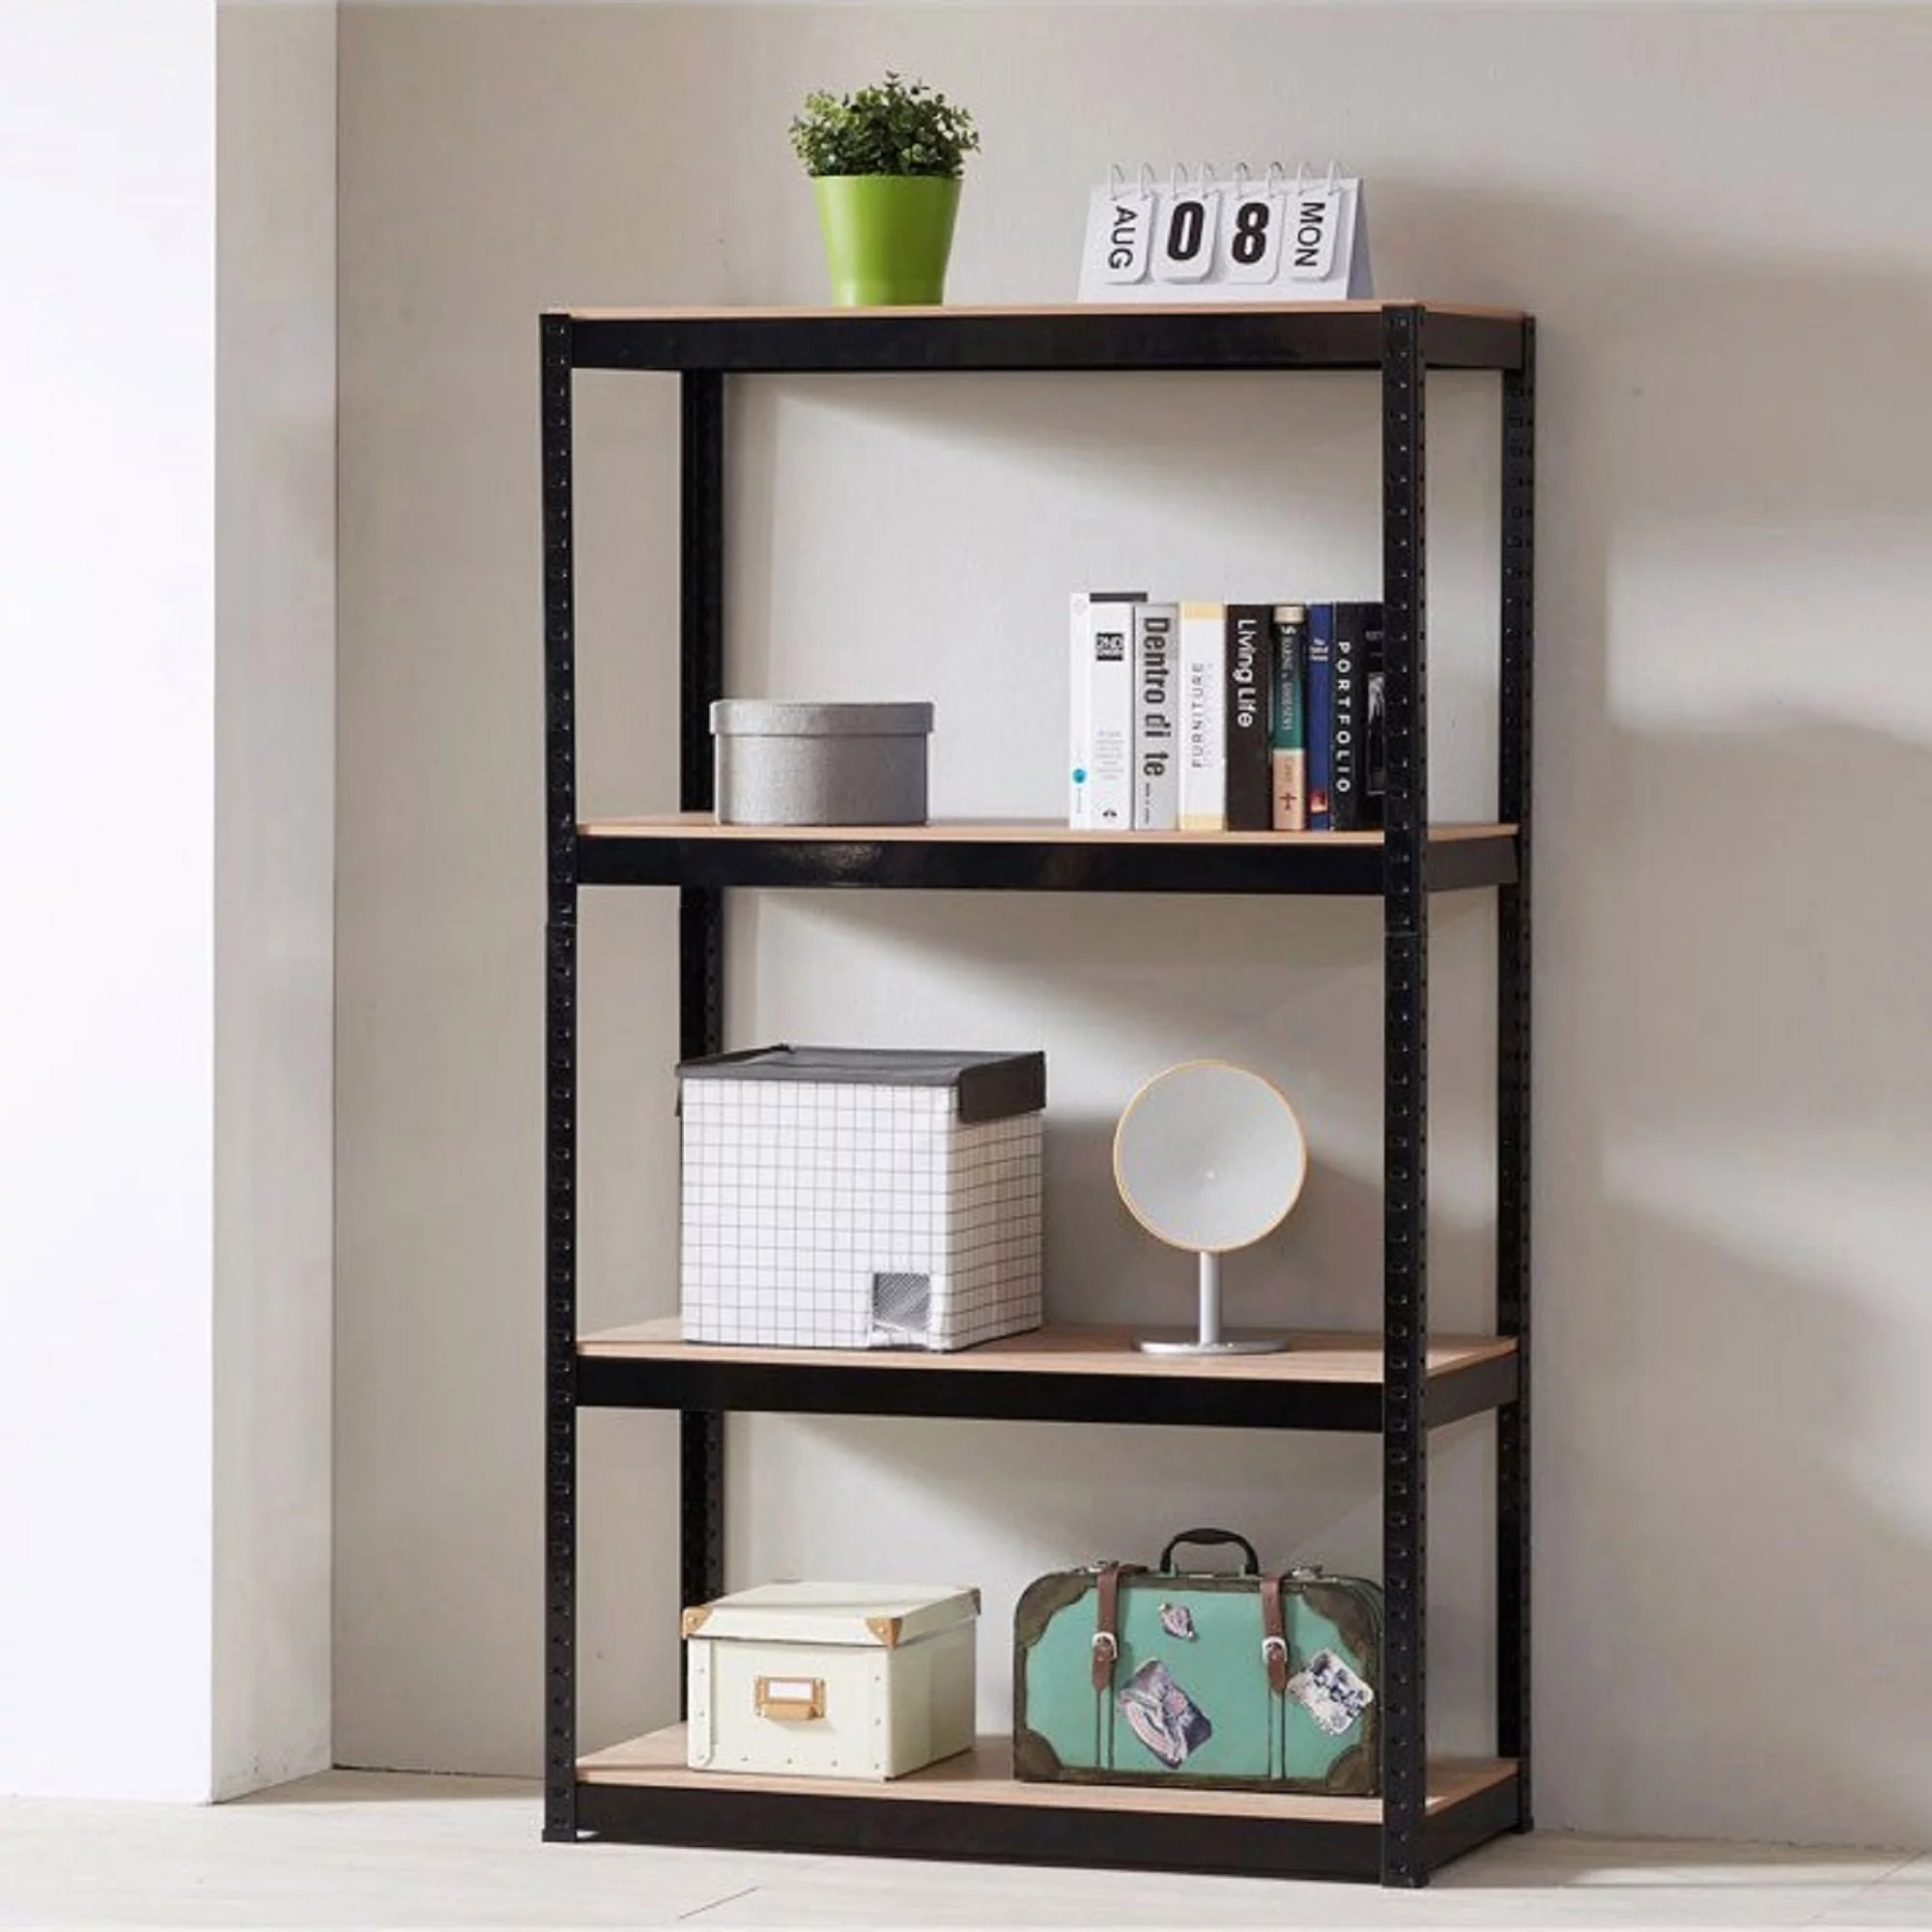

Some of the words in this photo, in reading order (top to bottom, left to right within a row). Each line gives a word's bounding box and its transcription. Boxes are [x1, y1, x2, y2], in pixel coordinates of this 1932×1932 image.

[1108, 205, 1138, 270] AUG
[1294, 202, 1326, 268] MON
[1143, 617, 1171, 704] Dentro
[1233, 618, 1256, 683] Living
[1144, 713, 1172, 739] di
[1191, 663, 1205, 768] FURNITURE
[1237, 687, 1256, 728] Life
[1336, 641, 1351, 793] PORTFOLIO
[1143, 752, 1170, 778] te
